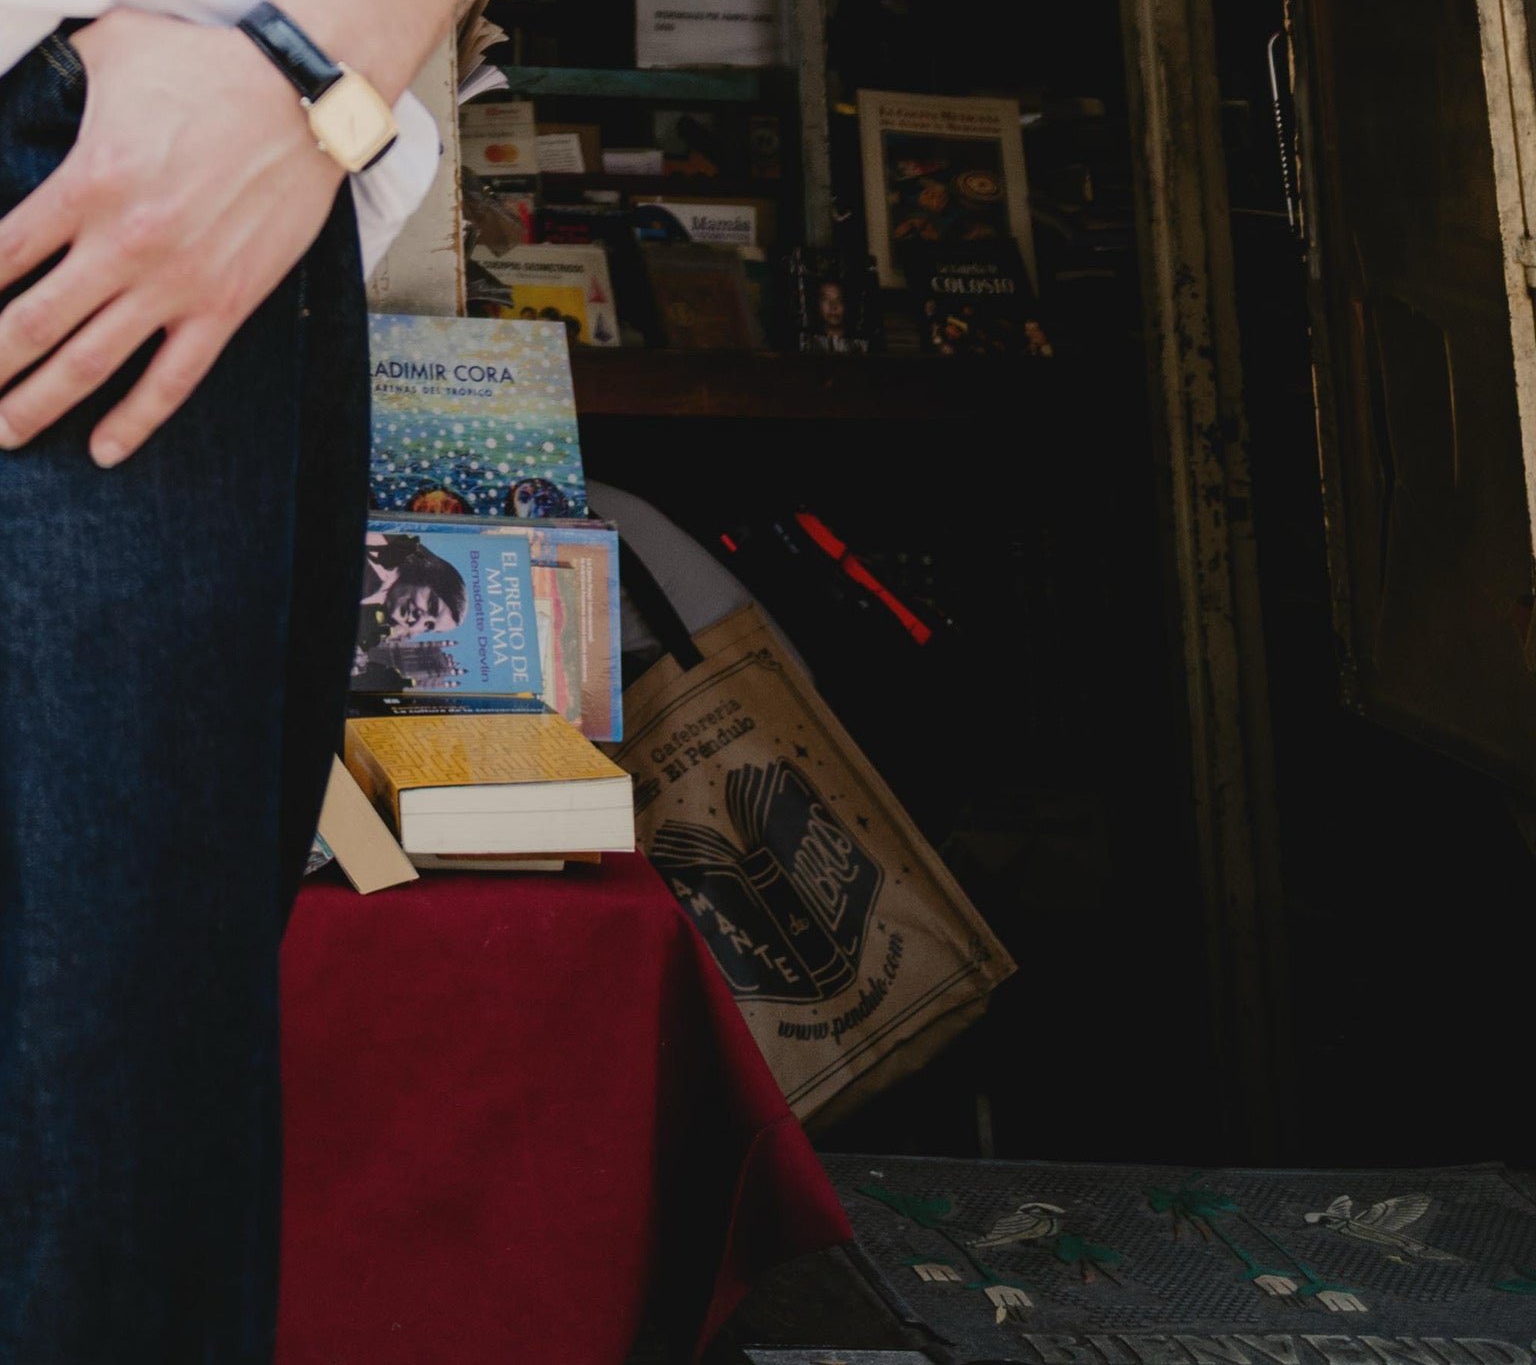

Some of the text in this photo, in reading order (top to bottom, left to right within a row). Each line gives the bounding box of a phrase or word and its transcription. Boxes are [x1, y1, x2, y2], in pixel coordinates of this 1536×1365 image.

[453, 364, 514, 383] CORA
[469, 549, 490, 683] Bernadette Devlin
[484, 567, 509, 666] MI ALMA
[500, 551, 530, 683] EL PRECIO DE
[661, 716, 757, 784] El Péndulo
[792, 802, 859, 933] LIBROS
[670, 876, 801, 985] AMANTE
